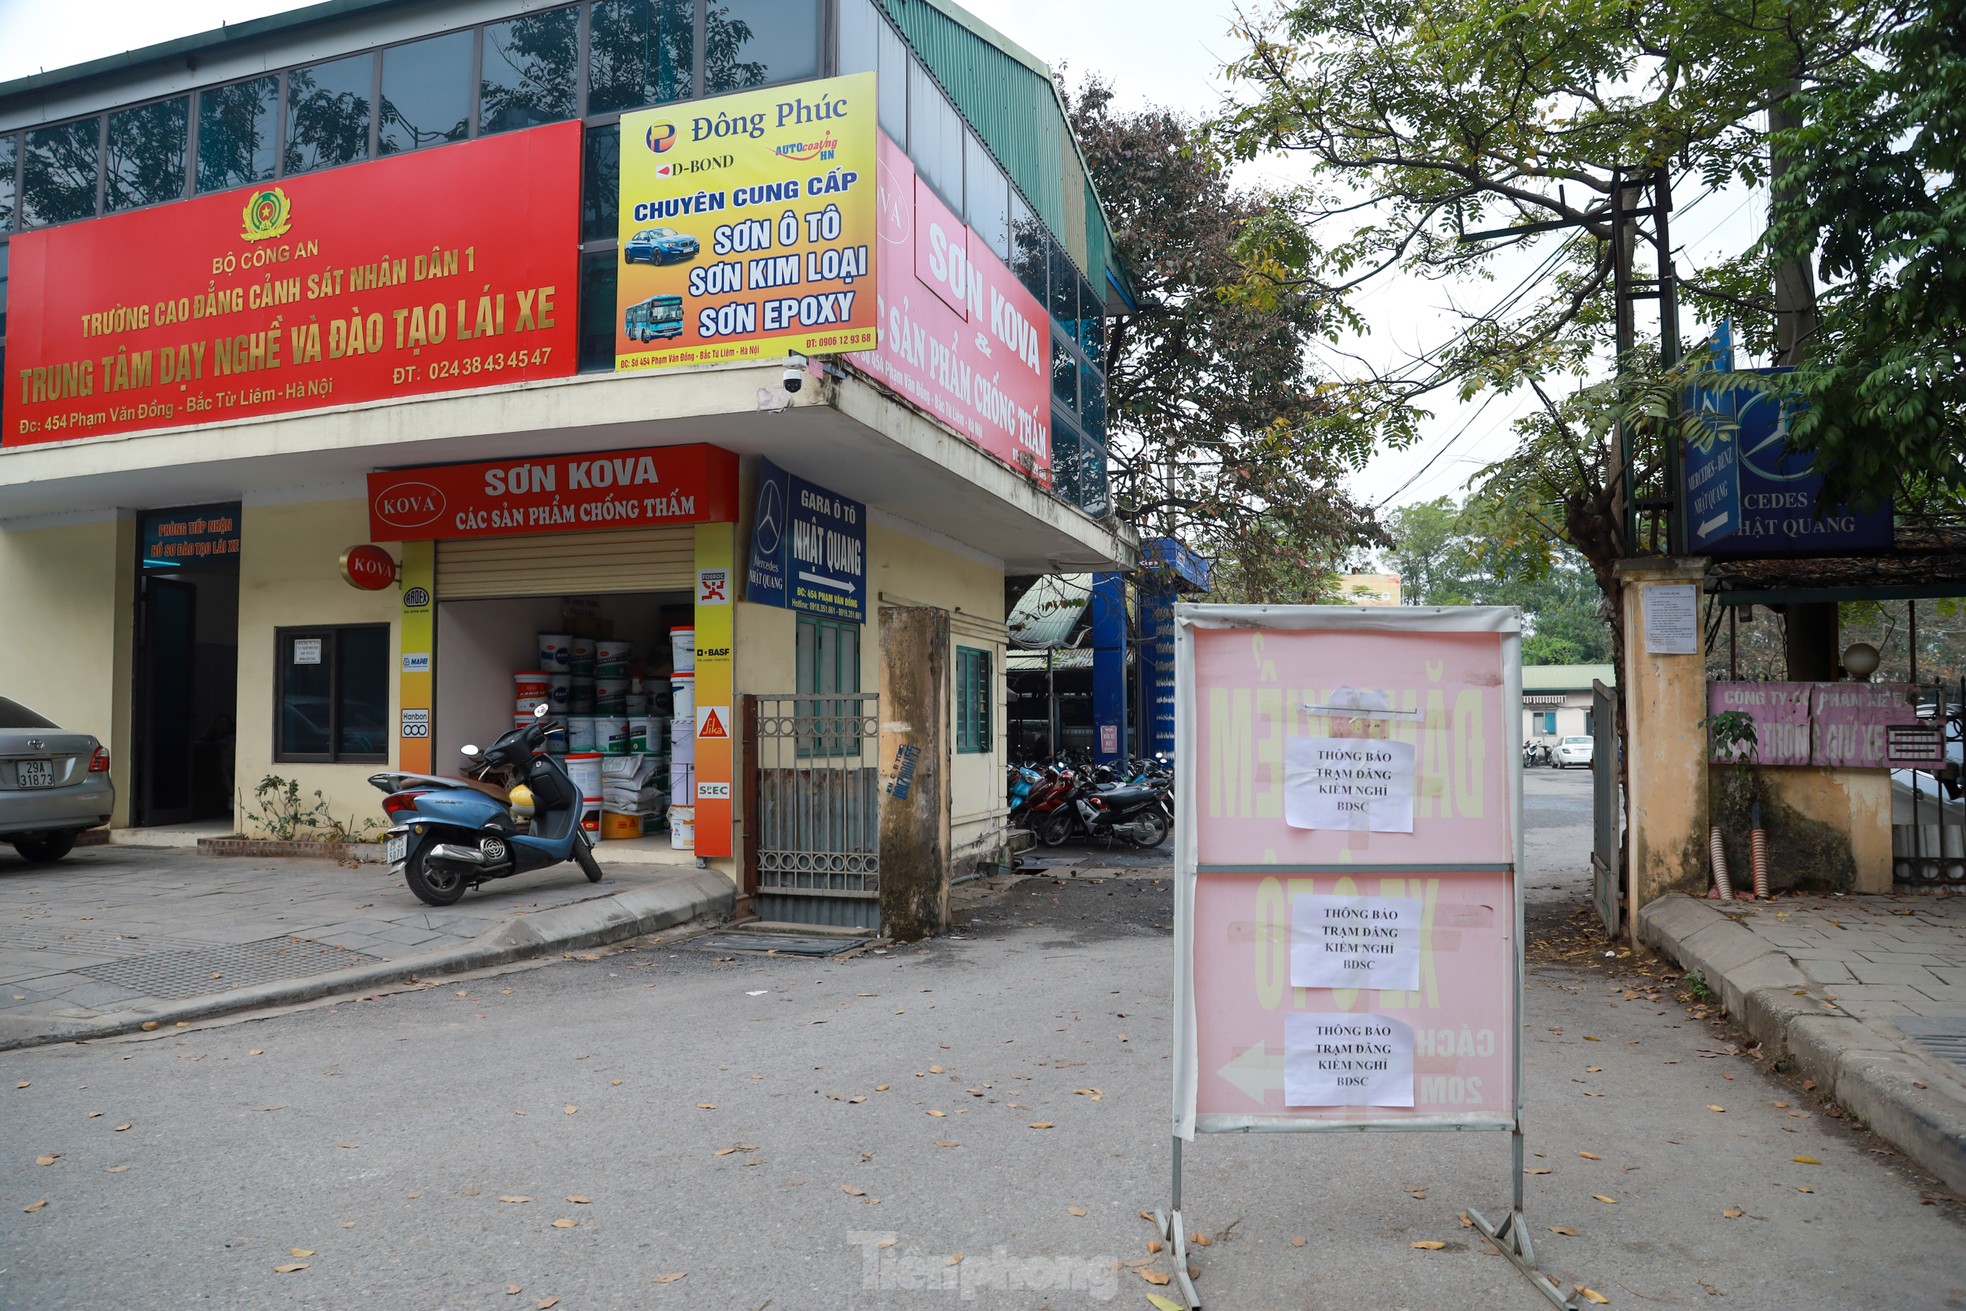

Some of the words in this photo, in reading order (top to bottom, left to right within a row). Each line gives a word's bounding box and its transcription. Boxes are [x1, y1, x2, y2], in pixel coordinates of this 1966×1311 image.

[692, 111, 766, 142] Đông
[776, 93, 848, 128] Phúc
[672, 154, 734, 176] D-BOND
[820, 150, 835, 161] HN
[634, 191, 725, 222] CHUYÊN
[732, 179, 799, 208] CUNG
[807, 167, 858, 195] CẤP
[714, 219, 773, 255] SƠN
[779, 209, 799, 246] Ô
[805, 204, 841, 242] TÔ
[212, 252, 236, 276] BỘ
[241, 245, 290, 270] CÔNG
[294, 239, 319, 259] AN
[689, 261, 741, 296] SƠN
[749, 255, 799, 290] KIM
[807, 245, 868, 284] LOẠI
[81, 303, 149, 338] TRƯỜNG
[155, 297, 189, 326] CAO
[193, 280, 243, 319] ĐẲNG
[250, 273, 301, 309] CẢNH
[307, 266, 344, 300] SÁT
[350, 255, 407, 292] NHÂN
[414, 245, 459, 281] DÂN
[465, 246, 475, 272] 1
[929, 222, 984, 324] SƠN
[990, 285, 1042, 376] KOVA
[699, 301, 755, 338] SƠN
[764, 291, 855, 331] EPOXY
[19, 359, 94, 405] TRUNG
[101, 345, 153, 393] TÂM
[160, 340, 206, 391] DẠY
[214, 314, 284, 377] NGHỀ
[291, 315, 322, 365] VÀ
[329, 306, 384, 359] ĐÀO
[393, 303, 447, 356] TẠO
[457, 284, 505, 340] LÁI
[515, 286, 556, 333] XE
[839, 336, 848, 345] 12
[850, 335, 860, 344] 93
[862, 333, 871, 343] 68
[975, 332, 992, 360] &
[393, 366, 421, 385] ĐT:
[890, 296, 926, 373] SẢN
[930, 330, 971, 406] PHẨM
[974, 371, 1016, 437] CHỐNG
[1018, 404, 1047, 460] THẤM
[19, 420, 41, 434] Đc:
[44, 414, 67, 431] 454
[70, 412, 106, 429] Phạm
[109, 404, 135, 422] Văn
[138, 399, 174, 419] Đồng
[187, 392, 213, 412] Bắc
[216, 391, 237, 408] Từ
[240, 388, 276, 405] Liêm
[285, 382, 305, 399] Hà
[308, 377, 333, 398] Nội
[484, 463, 556, 496] SƠN
[568, 455, 659, 490] KOVA
[383, 496, 436, 515] KOVA
[455, 507, 487, 530] CÁC
[491, 501, 524, 528] SẢN
[529, 494, 575, 526] PHẨM
[579, 493, 639, 522] CHỐNG
[644, 488, 695, 518] THẤM
[801, 489, 830, 516] GARA
[834, 499, 841, 519] Ô
[844, 505, 856, 524] TÔ
[1742, 492, 1808, 510] CEDES
[159, 521, 187, 536] PHÒNG
[208, 517, 232, 534] NHẬN
[1783, 516, 1855, 537] QUANG
[228, 539, 239, 552] XE
[794, 516, 824, 572] NHẬT
[827, 530, 861, 576] QUANG
[354, 557, 392, 577] KOVA
[754, 552, 778, 572] Mercedes
[762, 574, 782, 590] QUANG
[708, 648, 730, 657] BASF
[1724, 688, 1766, 705] CÔNG
[1770, 691, 1788, 705] TY
[703, 718, 722, 734] Sika
[1317, 749, 1362, 761] THÔNG
[1366, 750, 1391, 762] BÁO
[26, 761, 45, 774] 29A
[1317, 768, 1352, 780] TRẠM
[1357, 768, 1391, 780] ĐĂNG
[20, 774, 53, 786] 318.73
[699, 786, 728, 794] SPEC
[1337, 802, 1369, 811] BDSC
[1324, 907, 1368, 919] THÔNG
[1372, 908, 1398, 920] BÁO
[1322, 926, 1358, 938] TRẠM
[1363, 926, 1398, 938] ĐĂNG
[1344, 960, 1375, 970] BDSC
[1316, 1024, 1361, 1036] THÔNG
[1365, 1024, 1391, 1036] BÁO
[1315, 1044, 1352, 1055] TRẠM
[1356, 1042, 1391, 1054] ĐĂNG
[1337, 1077, 1369, 1086] BDSC
